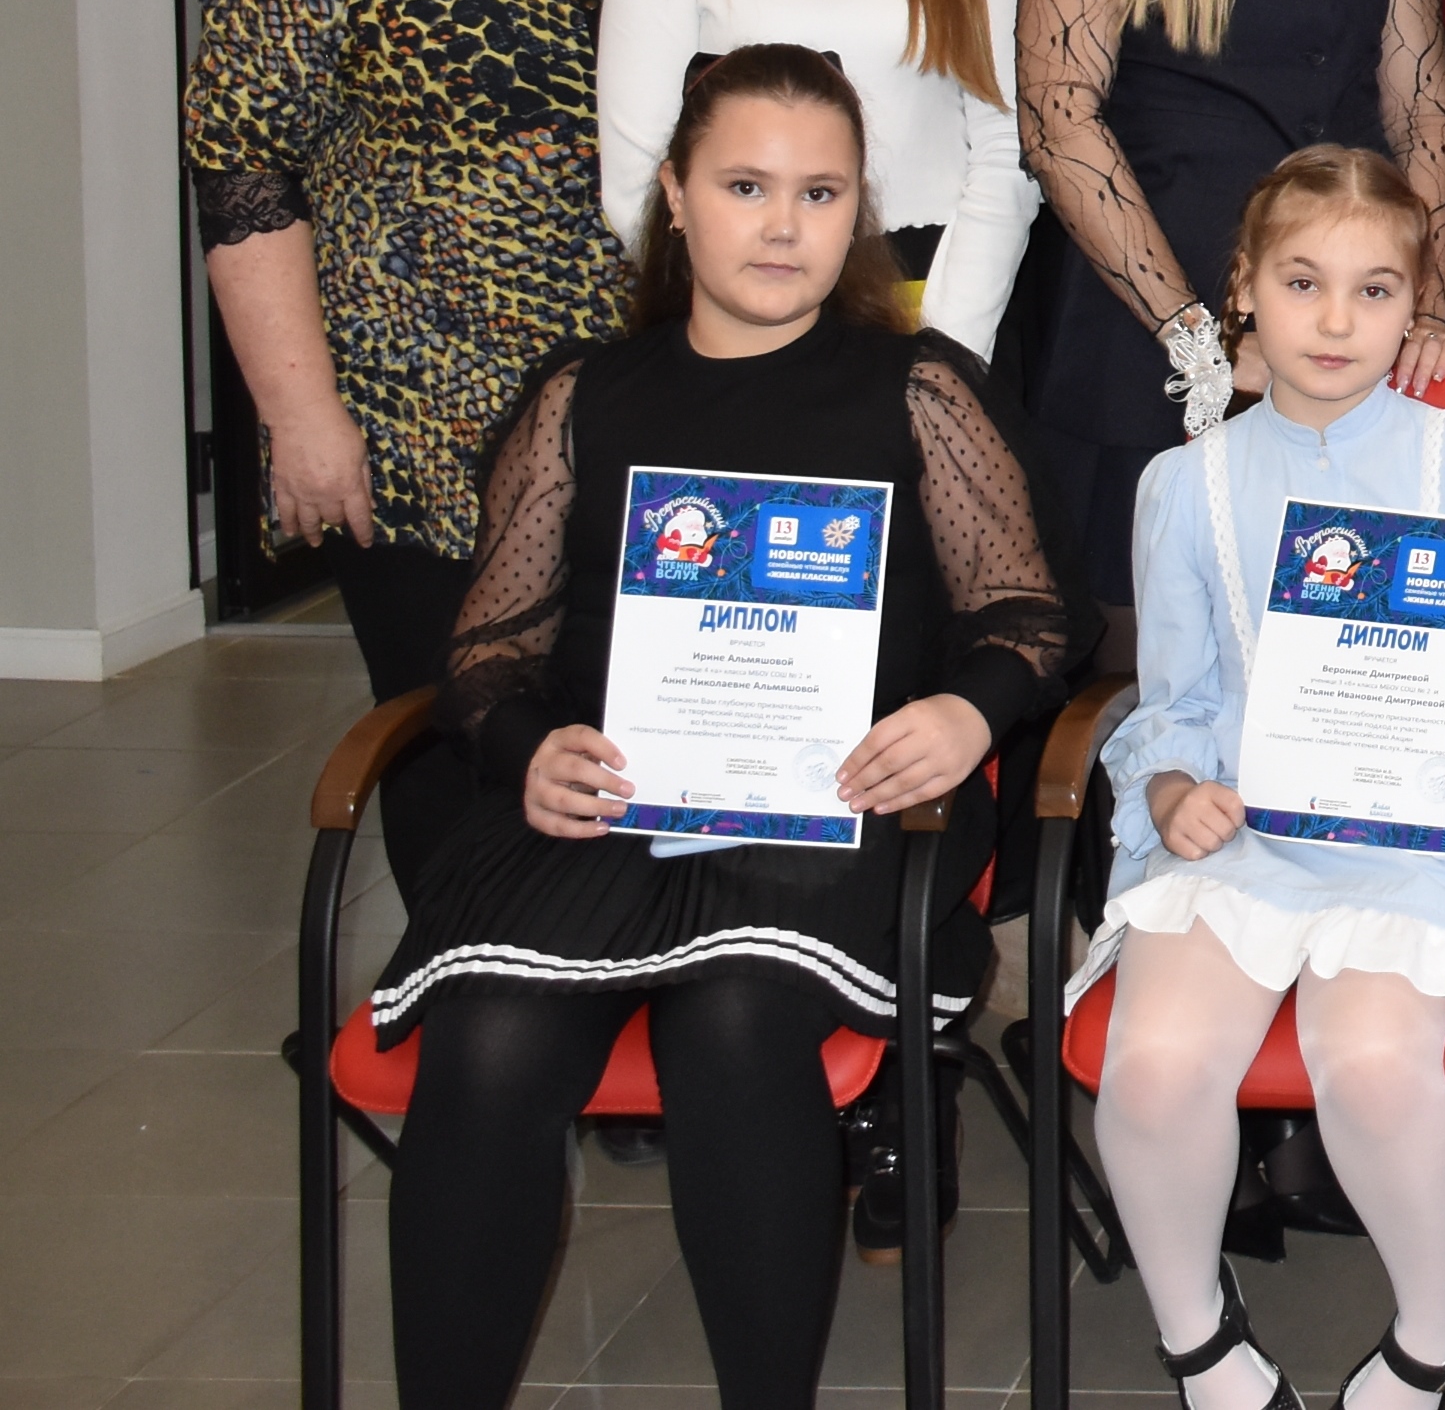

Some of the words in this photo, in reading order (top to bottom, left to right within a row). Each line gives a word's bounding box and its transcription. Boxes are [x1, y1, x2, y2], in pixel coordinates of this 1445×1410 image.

[775, 520, 792, 534] 13
[768, 549, 851, 565] НОВОГОДНИЕ
[1414, 551, 1430, 564] 13
[656, 559, 698, 571] ЧТЕНИЯ
[655, 568, 699, 581] ВСЛУХ
[766, 570, 800, 580] «ЖИВАЯ
[801, 572, 848, 583] КЛАССИКА»
[1302, 581, 1342, 593] ЧТЕНИЯ
[1301, 589, 1341, 602] ВСЛУХ
[1402, 595, 1434, 605] «ЖИВАЯ
[699, 604, 797, 634] ДИПЛОМ
[1337, 623, 1429, 652] ДИПЛОМ
